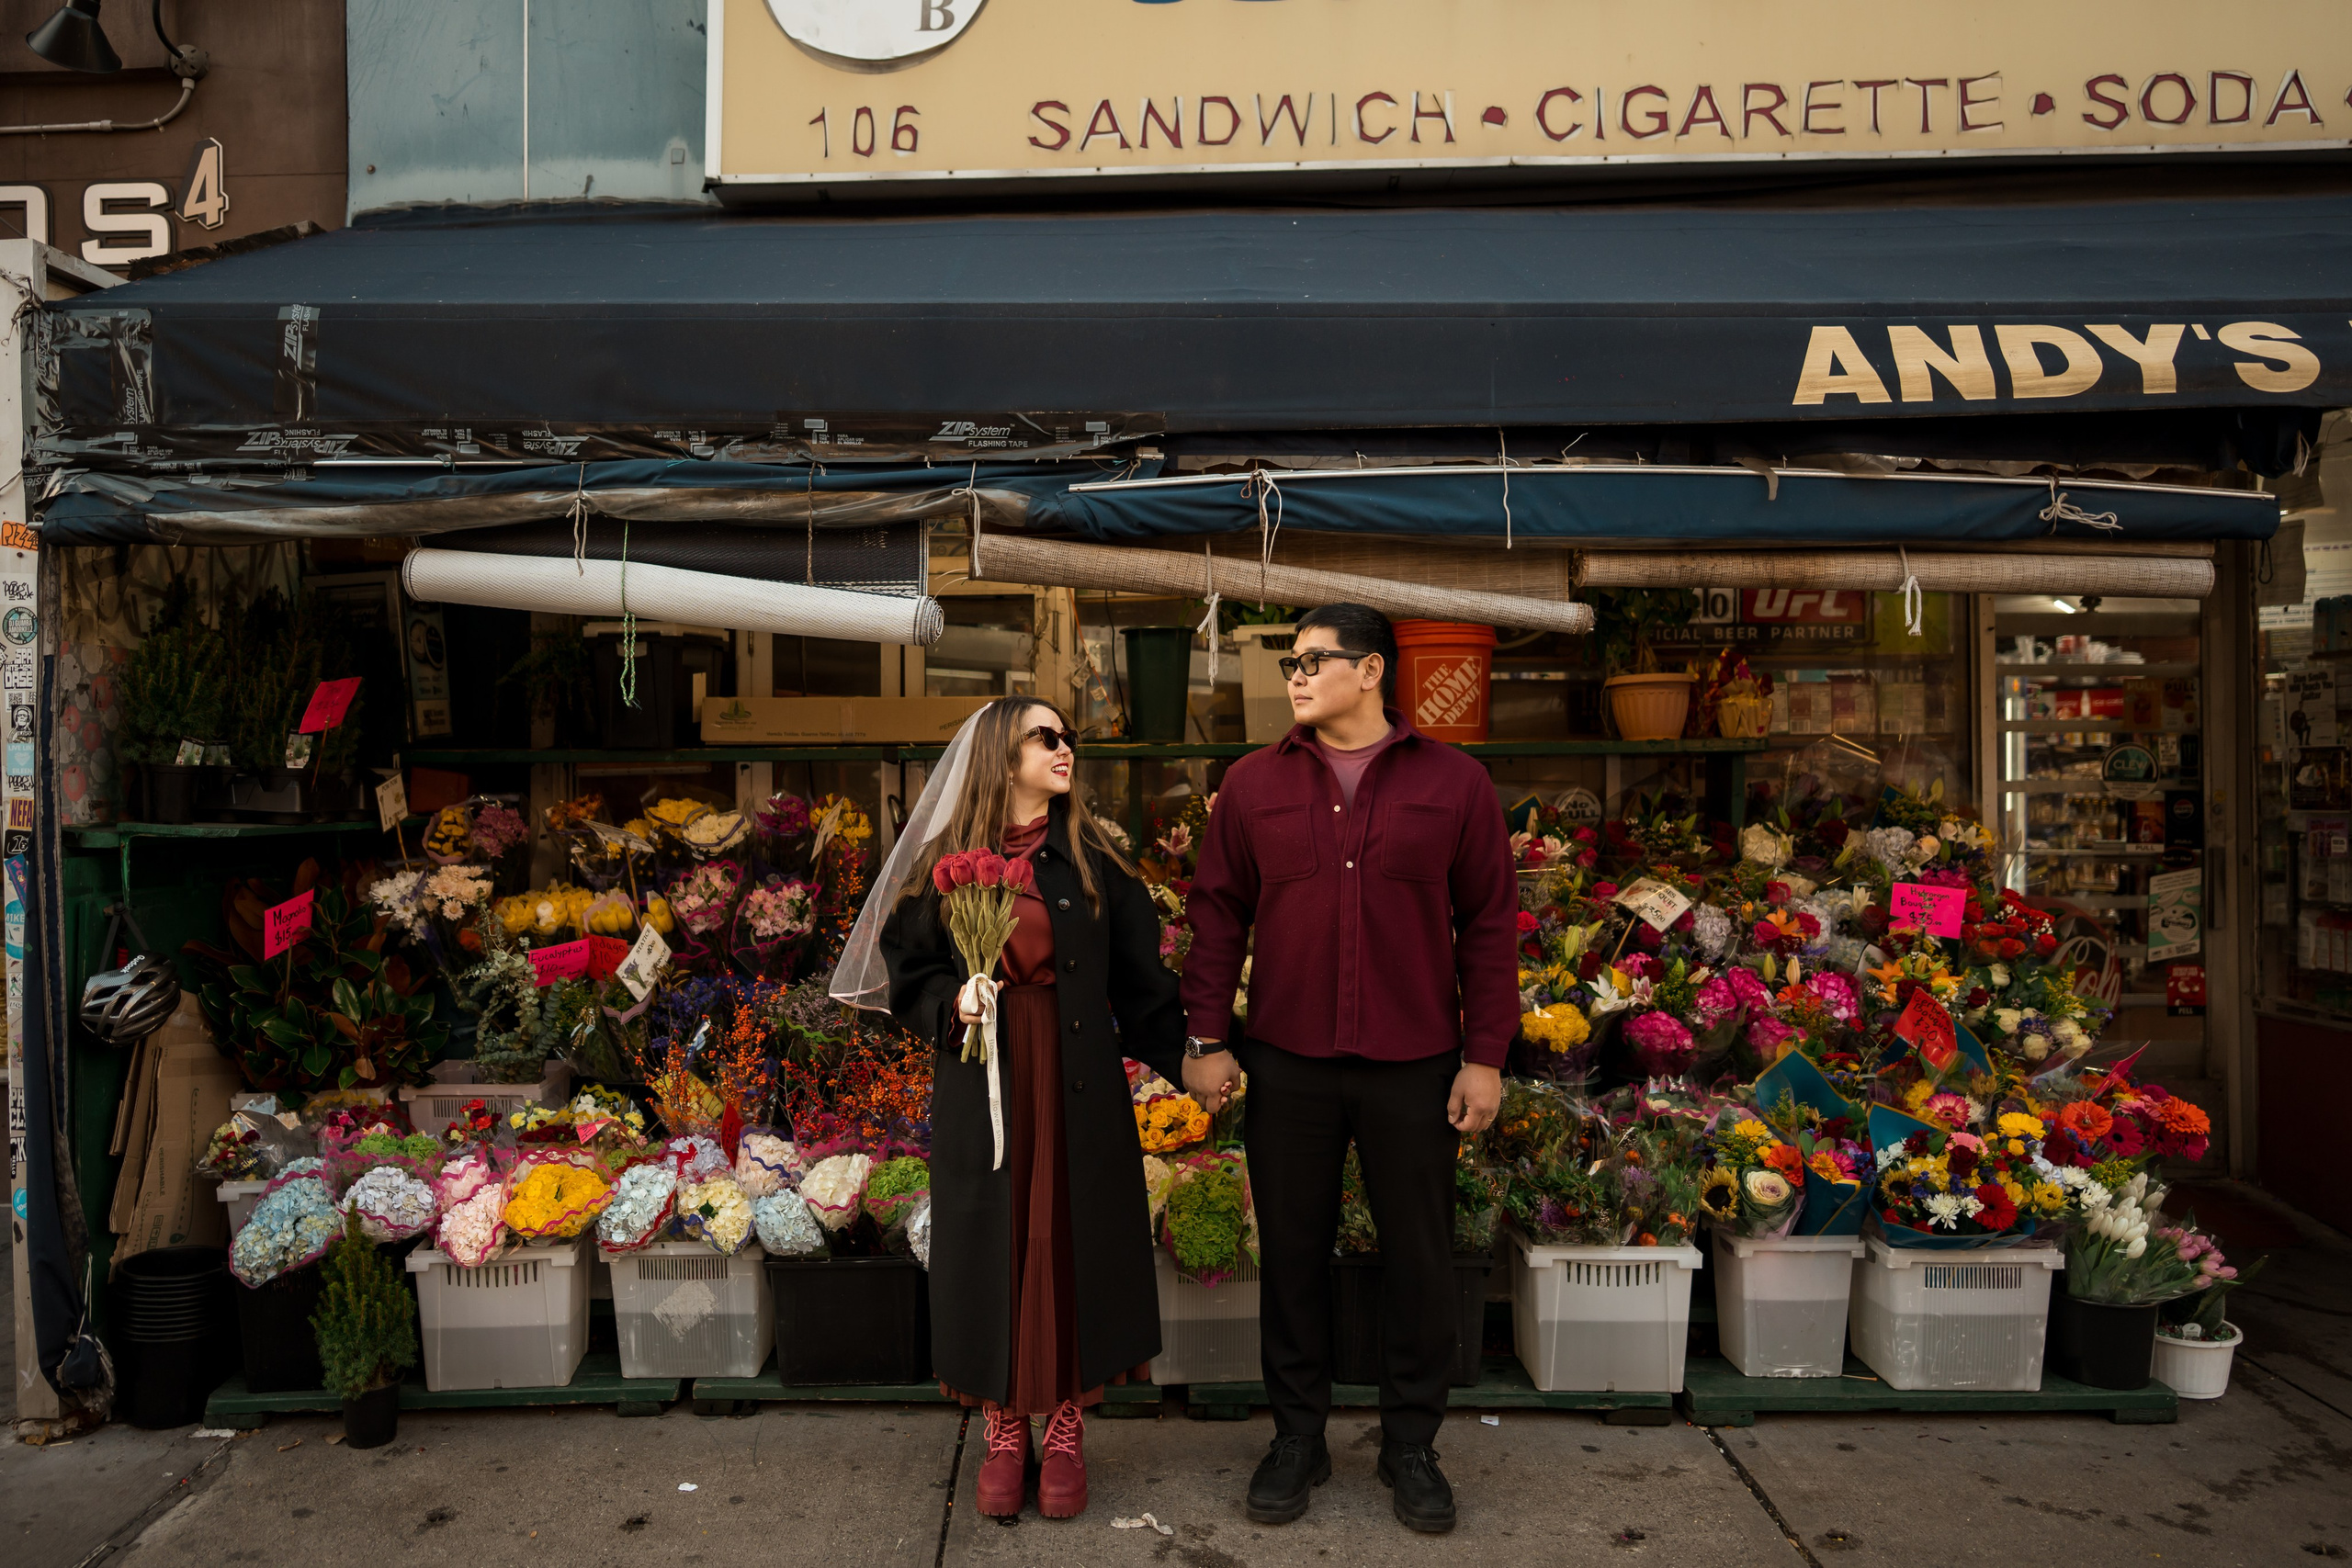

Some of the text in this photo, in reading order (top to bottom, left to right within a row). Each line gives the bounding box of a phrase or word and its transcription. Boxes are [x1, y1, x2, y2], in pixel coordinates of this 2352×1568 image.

[808, 69, 2325, 158] 106 SANDWICH CIGARETTE SODA
[1792, 321, 2321, 406] ANDY'S
[967, 440, 1029, 448] FLASHING TAPE
[1713, 627, 1758, 640] BEER
[1770, 626, 1855, 640] PARTNER
[1422, 663, 1453, 692] THE
[2126, 681, 2158, 692] PULL
[1417, 656, 1481, 726] HOME
[1442, 682, 1480, 726] DEPOT
[2113, 759, 2148, 771] CLEW
[530, 944, 583, 964] Eucalyptus
